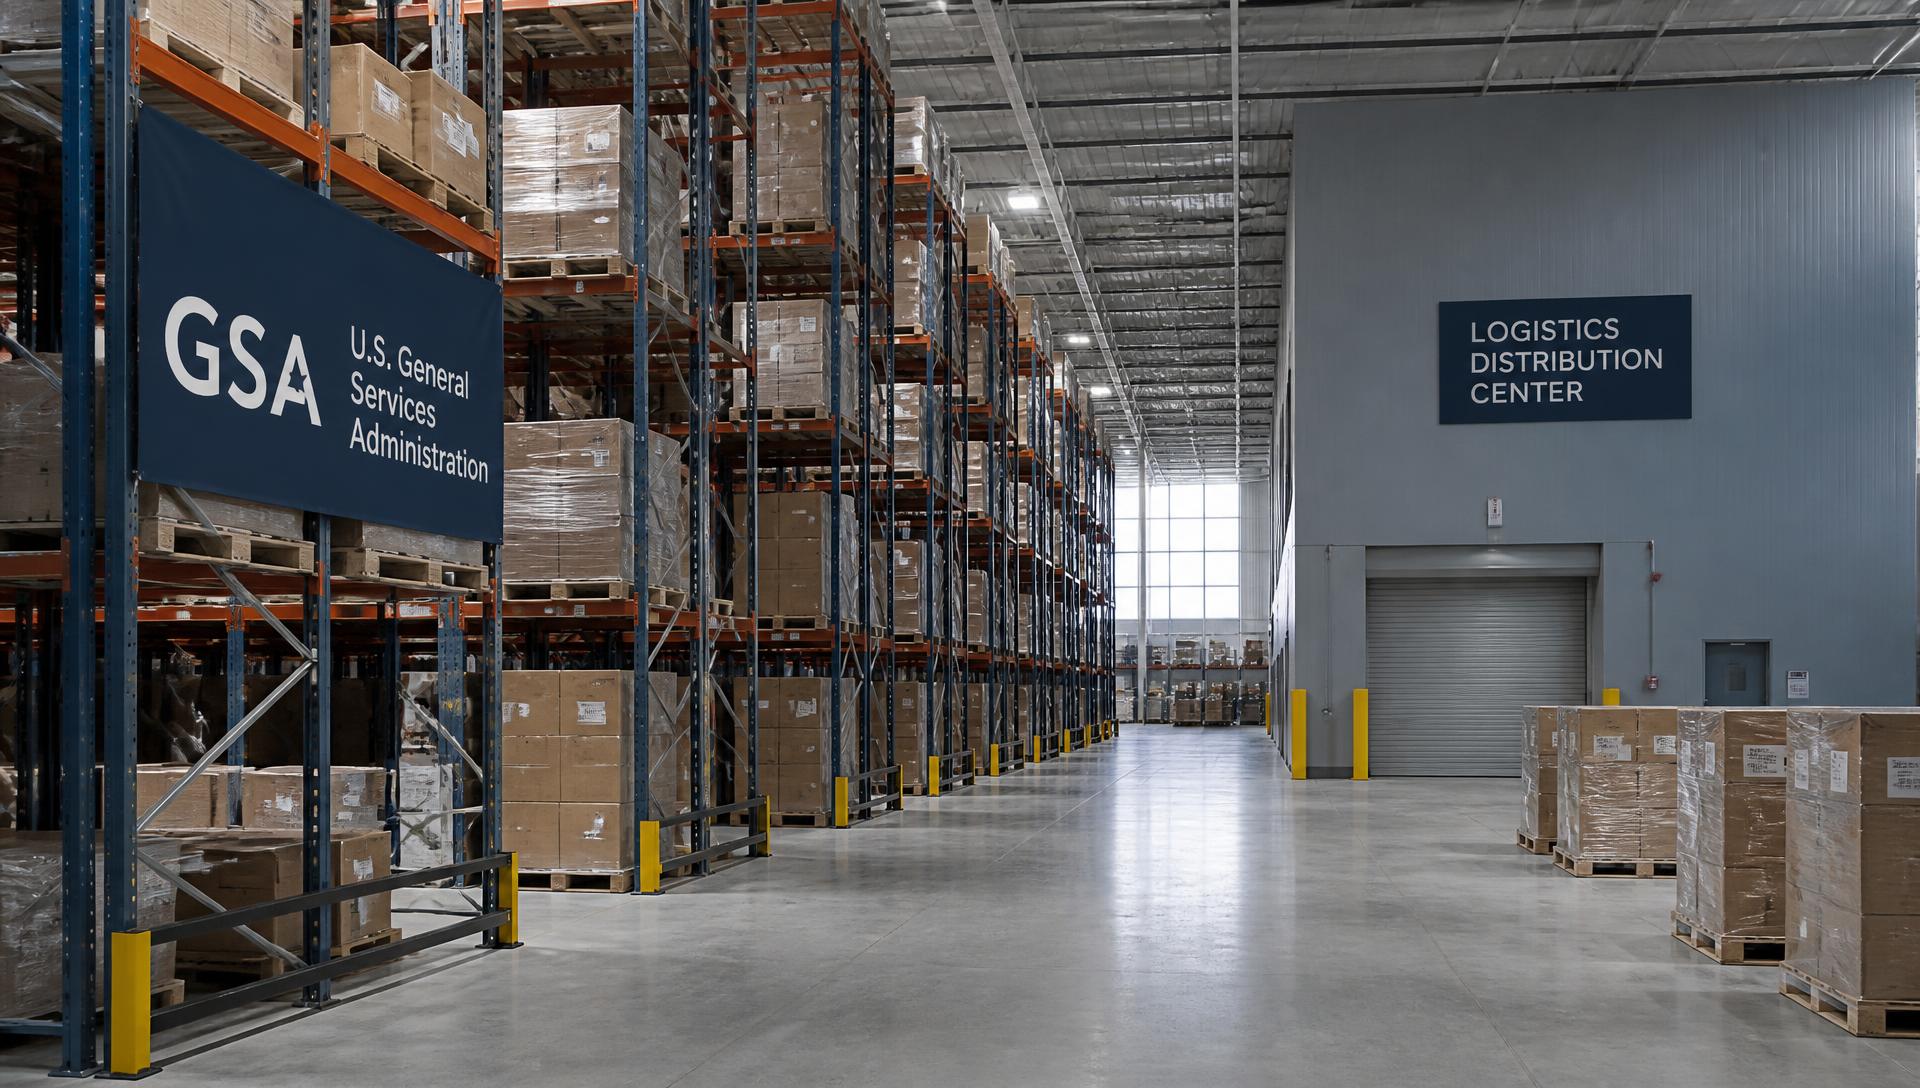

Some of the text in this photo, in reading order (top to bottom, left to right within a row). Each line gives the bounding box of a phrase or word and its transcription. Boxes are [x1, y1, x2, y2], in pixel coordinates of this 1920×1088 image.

[1470, 317, 1620, 343] LOGISTICS
[164, 295, 323, 427] GSA
[350, 325, 470, 401] U.S. General
[1470, 348, 1663, 374] DISTRIBUTION
[349, 370, 437, 430] Services
[1470, 380, 1584, 404] CENTER
[349, 416, 489, 485] Administration
